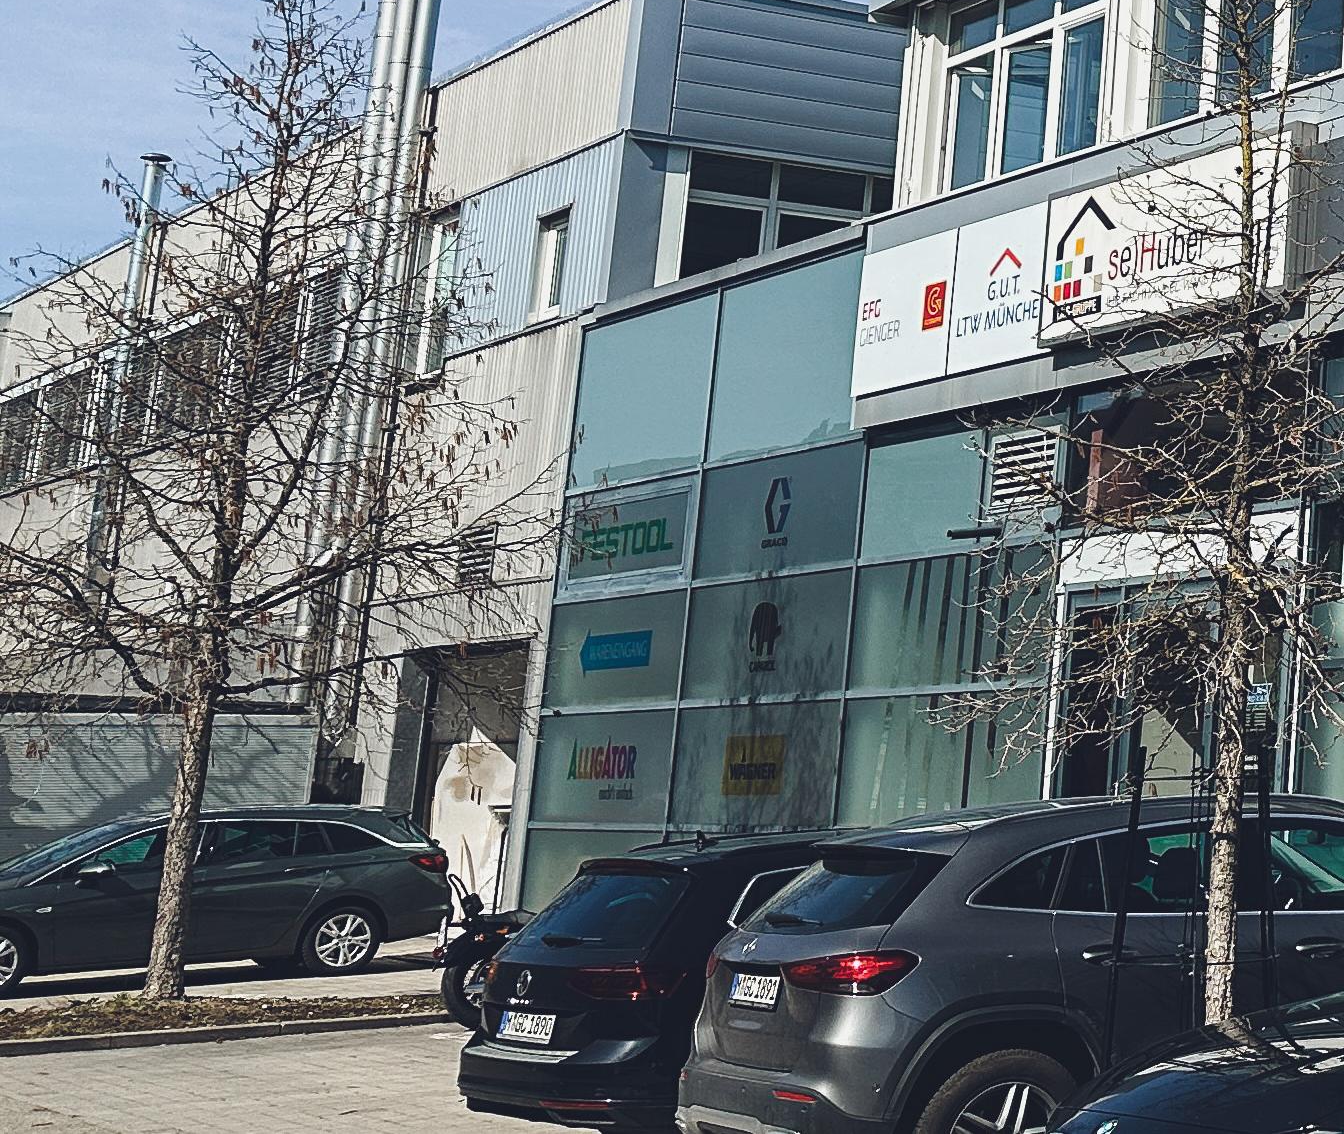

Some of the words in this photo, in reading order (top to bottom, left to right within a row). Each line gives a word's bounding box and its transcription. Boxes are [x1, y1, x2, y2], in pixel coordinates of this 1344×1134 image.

[862, 299, 882, 321] EFG
[956, 313, 982, 338] LTW
[984, 298, 1040, 332] MÜNCHE
[860, 320, 901, 347] GIENGER
[567, 735, 638, 781] ALLIGATOR
